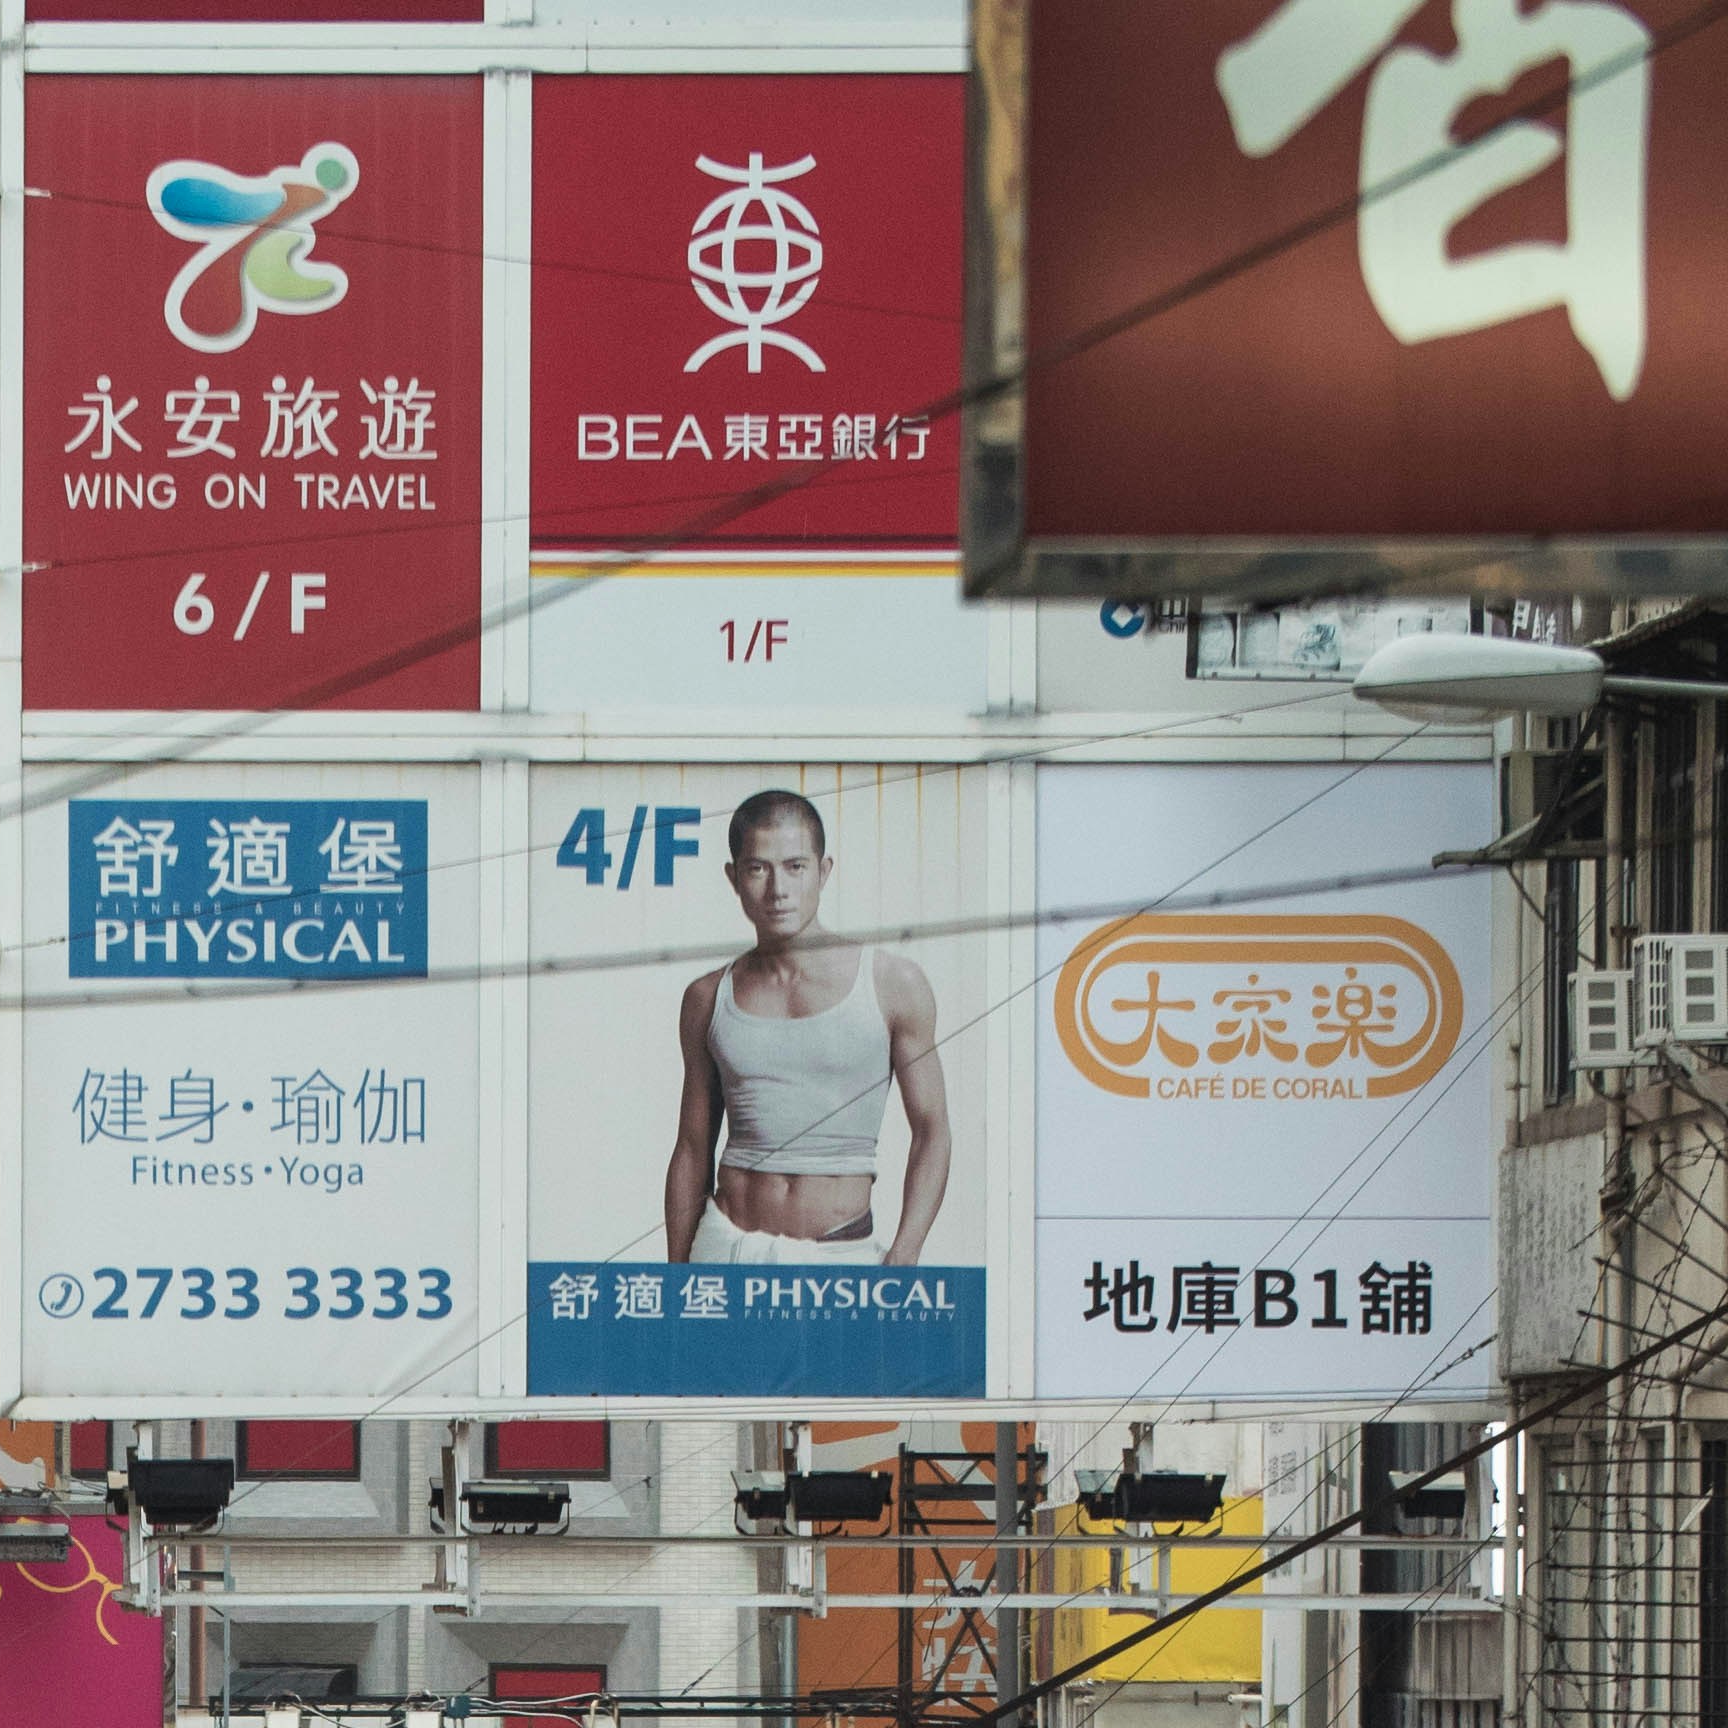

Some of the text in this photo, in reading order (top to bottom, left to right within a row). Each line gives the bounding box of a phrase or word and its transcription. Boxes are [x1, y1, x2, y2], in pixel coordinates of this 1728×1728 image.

[64, 375, 438, 461] 永安旅遊
[576, 413, 931, 462] BEA 東亞銀行
[64, 474, 437, 511] WING ON TRAVEL
[172, 571, 327, 641] 6/F
[718, 620, 789, 664] 1/F
[93, 817, 403, 898] 舒適堡
[556, 805, 702, 892] 4/F
[95, 901, 223, 917] FITNESS
[293, 901, 406, 917] BEAUTY
[94, 918, 405, 966] PHYSICAL
[1157, 1071, 1364, 1100] CAFÉ DE CORAL
[90, 1265, 453, 1321] 2733 3333
[548, 1271, 956, 1321] 舒適堡 PHYSICAL
[744, 1307, 834, 1320] FITNESS
[876, 1307, 956, 1320] BEAUTY
[1083, 1259, 1434, 1337] 地庫B1舖
